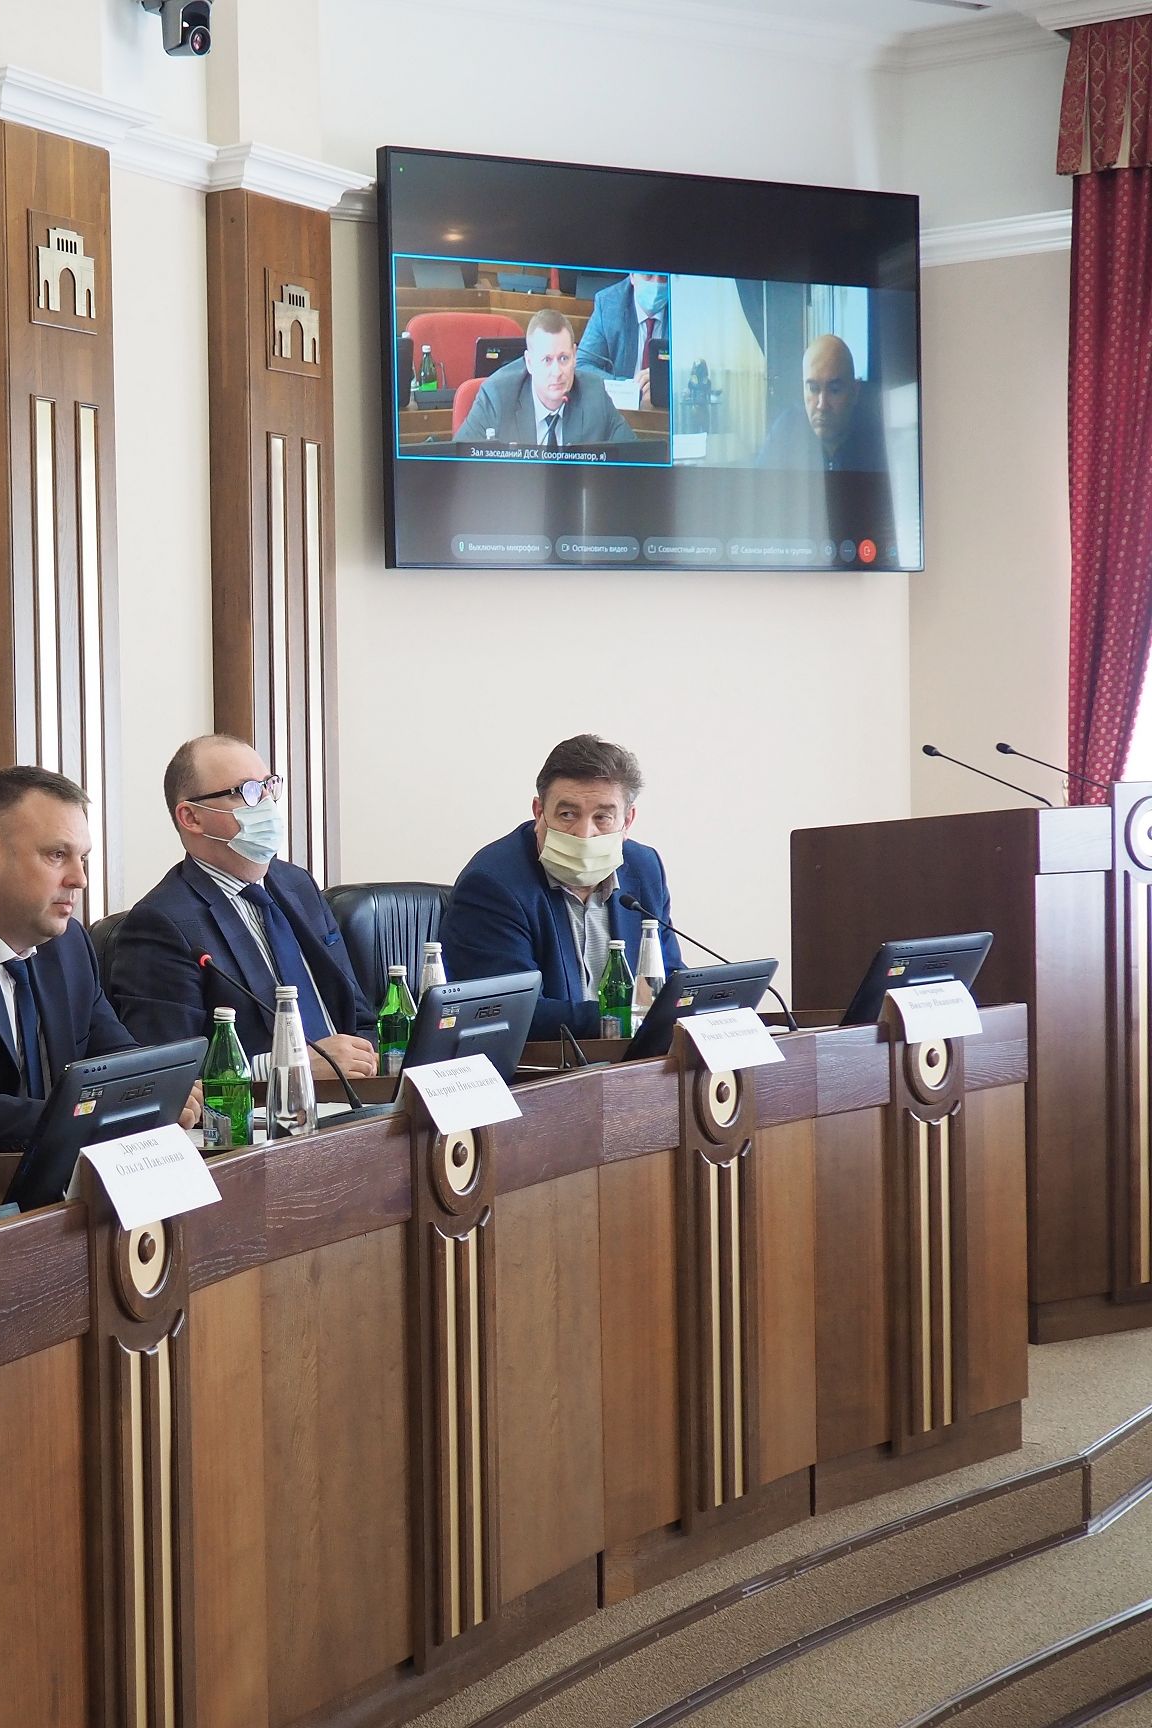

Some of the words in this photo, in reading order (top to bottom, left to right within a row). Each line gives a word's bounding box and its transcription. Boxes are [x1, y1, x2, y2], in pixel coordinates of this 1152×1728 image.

[471, 447, 484, 456] Зал
[485, 448, 522, 458] заседаний
[523, 449, 539, 459] ДСК
[541, 450, 599, 461] (соорганизатор,
[468, 543, 506, 552] Выключить
[506, 544, 540, 553] микрофон
[572, 544, 609, 552] Остановить
[609, 545, 628, 553] видео
[425, 1084, 456, 1098] Валерий
[455, 1077, 500, 1092] Николаевич
[115, 1161, 144, 1177] Ольга
[142, 1151, 185, 1169] Павловна
